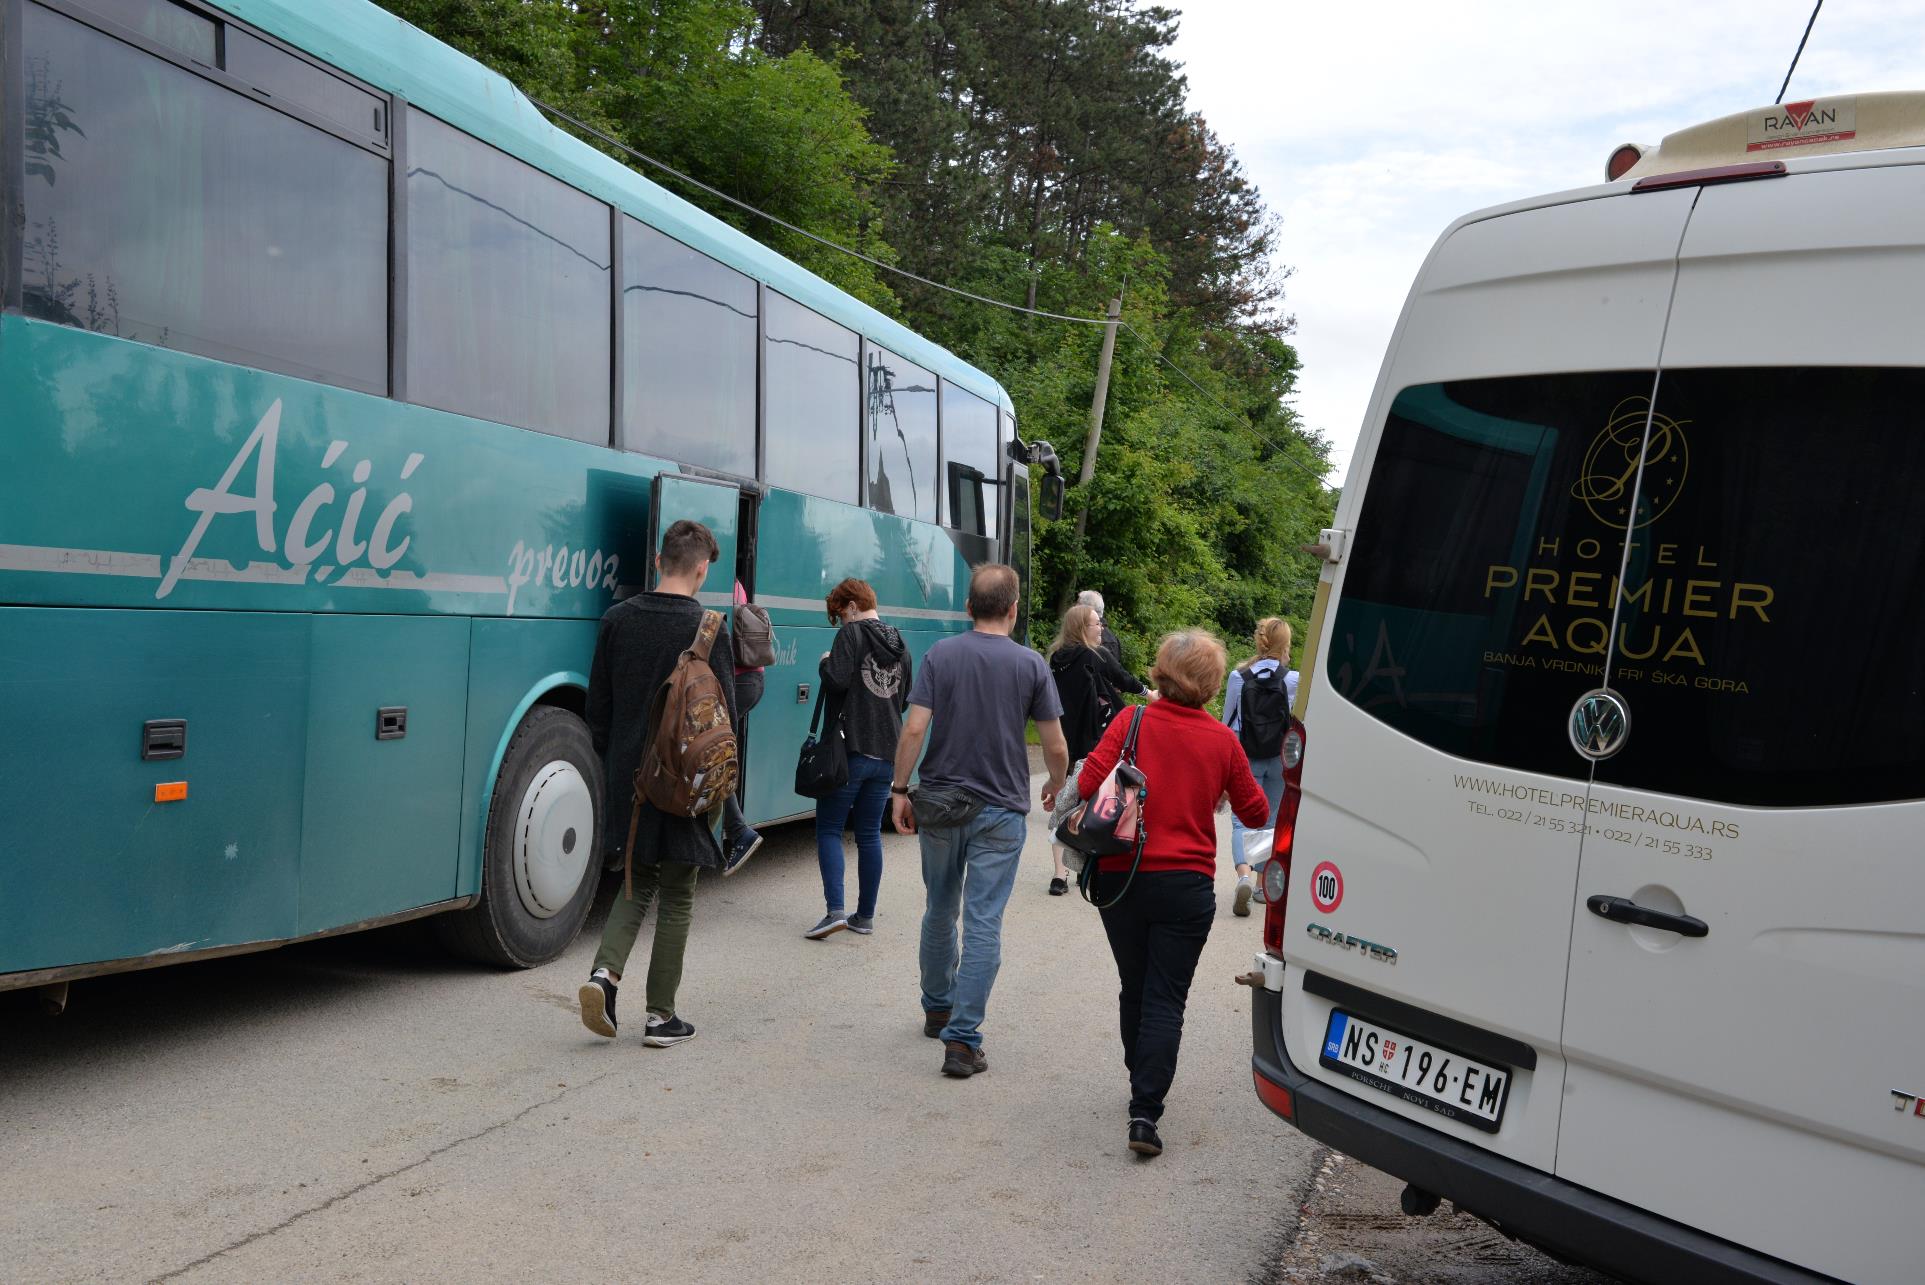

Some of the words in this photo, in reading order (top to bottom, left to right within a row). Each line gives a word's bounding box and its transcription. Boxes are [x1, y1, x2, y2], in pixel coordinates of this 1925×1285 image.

[1764, 108, 1836, 131] RAYAN
[1537, 536, 1718, 567] HOTEL
[506, 539, 620, 617] prevoz
[1484, 565, 1775, 623] PREMIER
[1520, 613, 1706, 666] AQUA
[1482, 650, 1536, 668] BANJA
[1694, 676, 1750, 694] GORA
[1453, 774, 1740, 839] WWW.HOTELPREMIERAQUA.RS
[1467, 800, 1494, 817] TEL.
[1498, 807, 1523, 822] 022
[1533, 814, 1546, 827] 21
[1549, 817, 1565, 832] 55
[1604, 828, 1632, 844] 022
[1645, 836, 1659, 850] 21
[1663, 839, 1680, 855] 55
[1684, 844, 1713, 861] 333
[1318, 874, 1336, 900] 100
[1306, 922, 1398, 965] CRAFTER
[1327, 1041, 1340, 1054] SRB
[1343, 1023, 1379, 1066] NS
[1351, 1071, 1392, 1094] PORSCHE
[1402, 1091, 1429, 1109] NOVI
[1434, 1103, 1456, 1118] SAD
